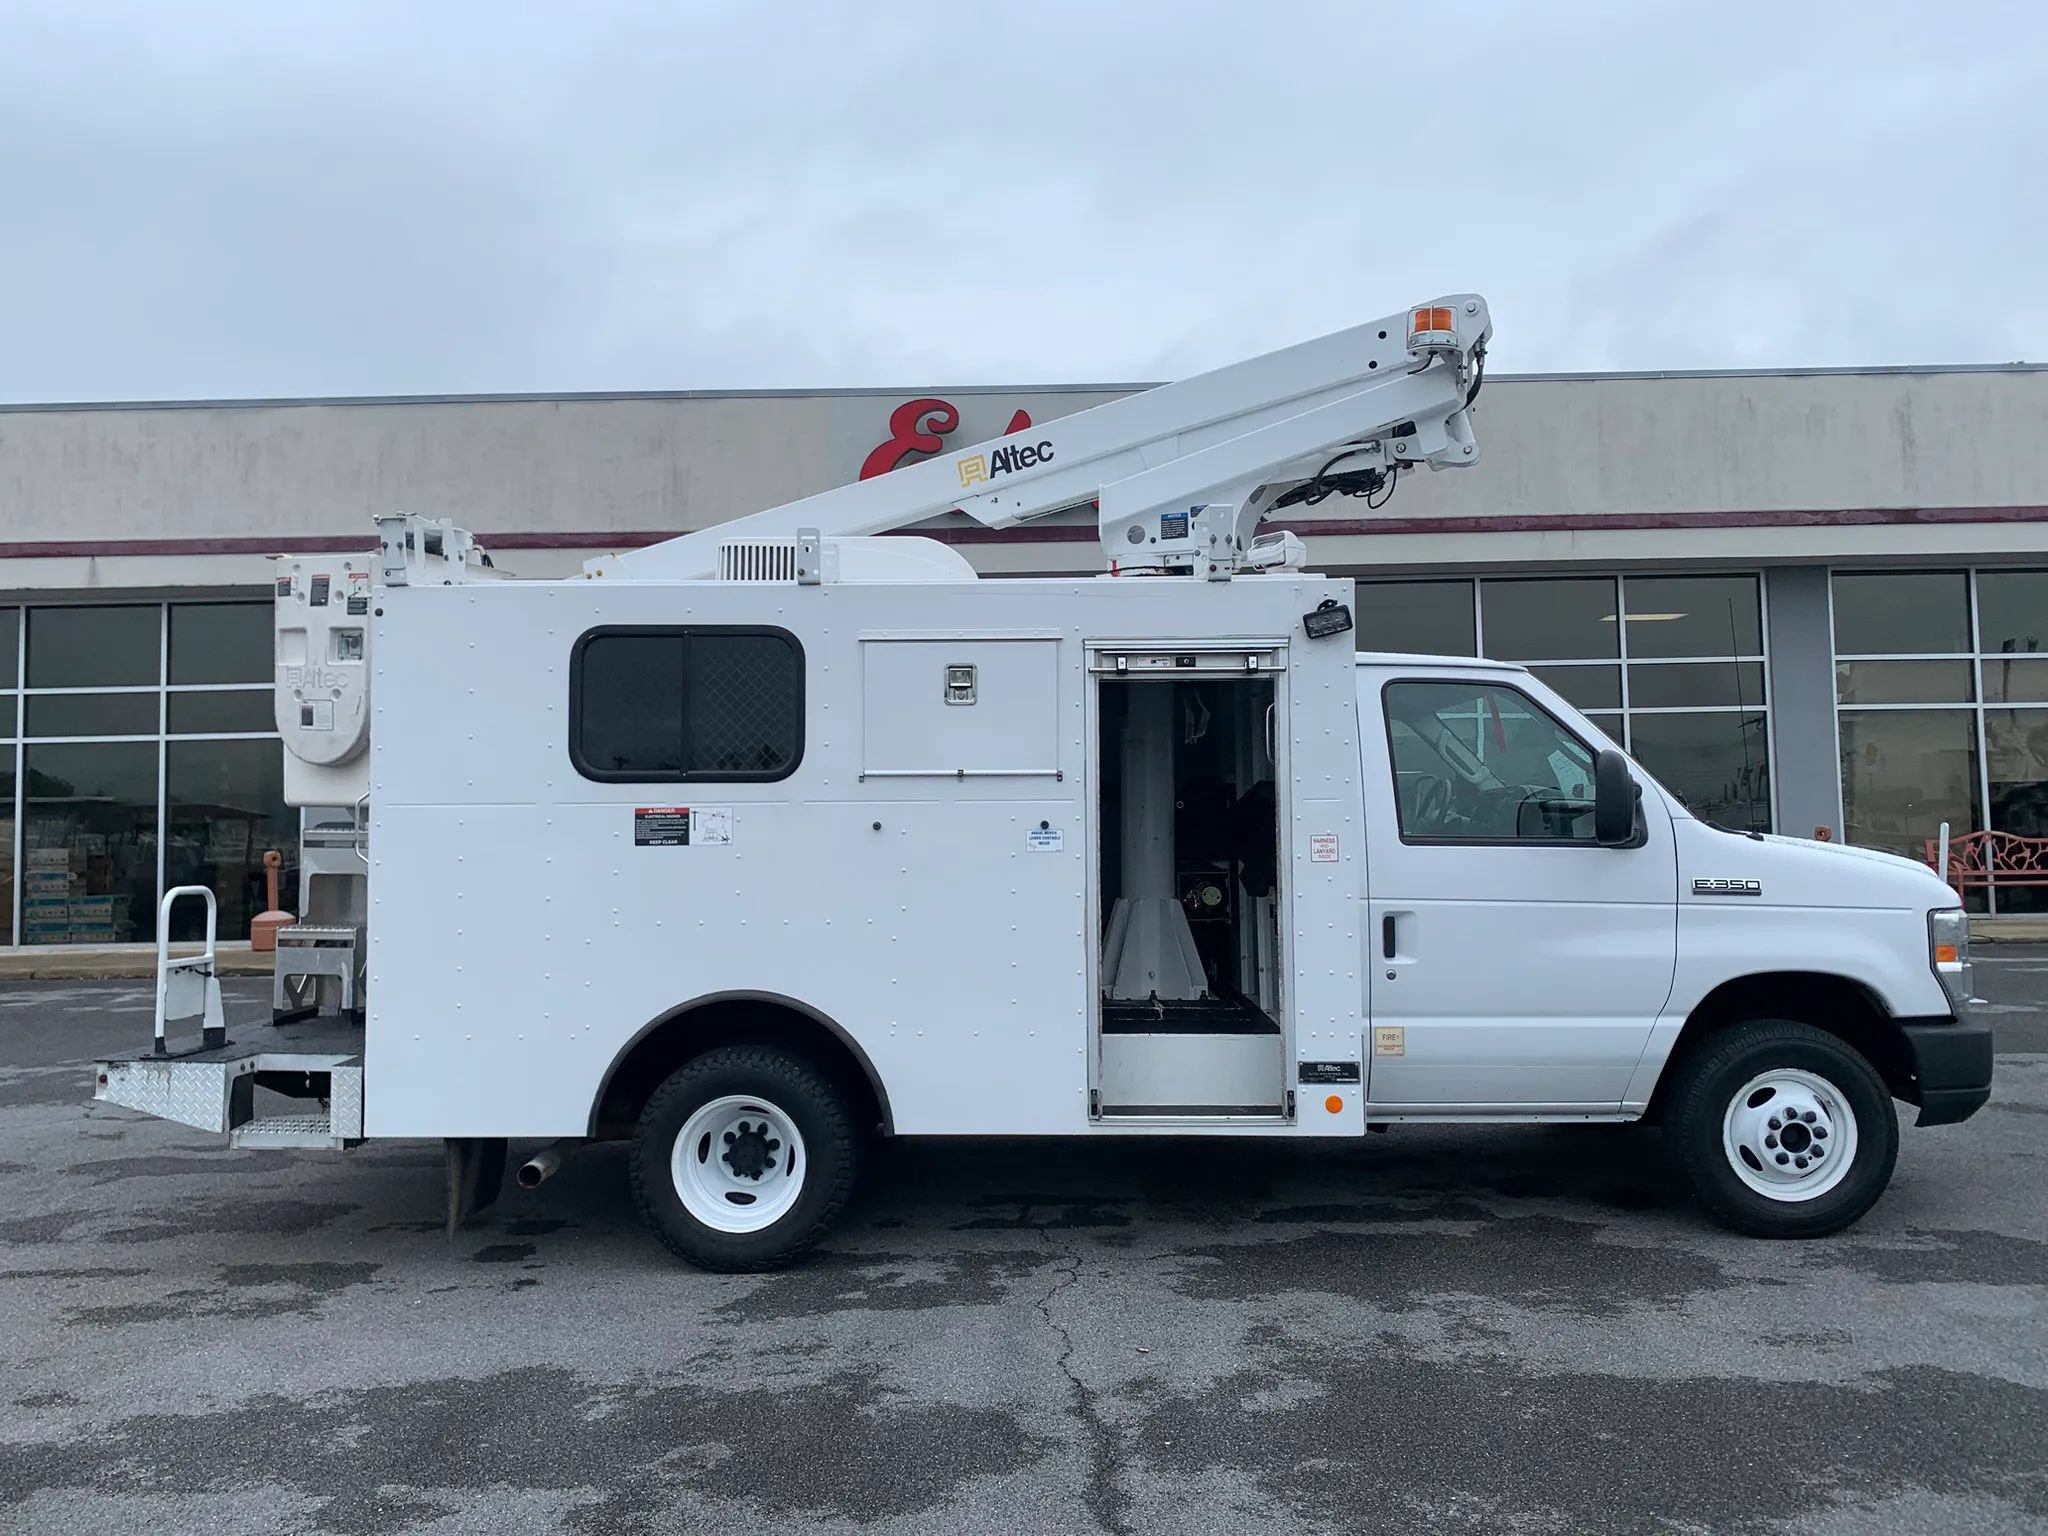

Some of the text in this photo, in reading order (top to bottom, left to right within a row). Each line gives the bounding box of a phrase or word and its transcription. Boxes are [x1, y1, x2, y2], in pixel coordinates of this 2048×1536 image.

[989, 440, 1055, 479] Altec
[302, 667, 350, 689] Altec
[1692, 878, 1762, 890] E-350
[1382, 1033, 1397, 1041] FIRE
[1325, 1064, 1341, 1072] Altec
